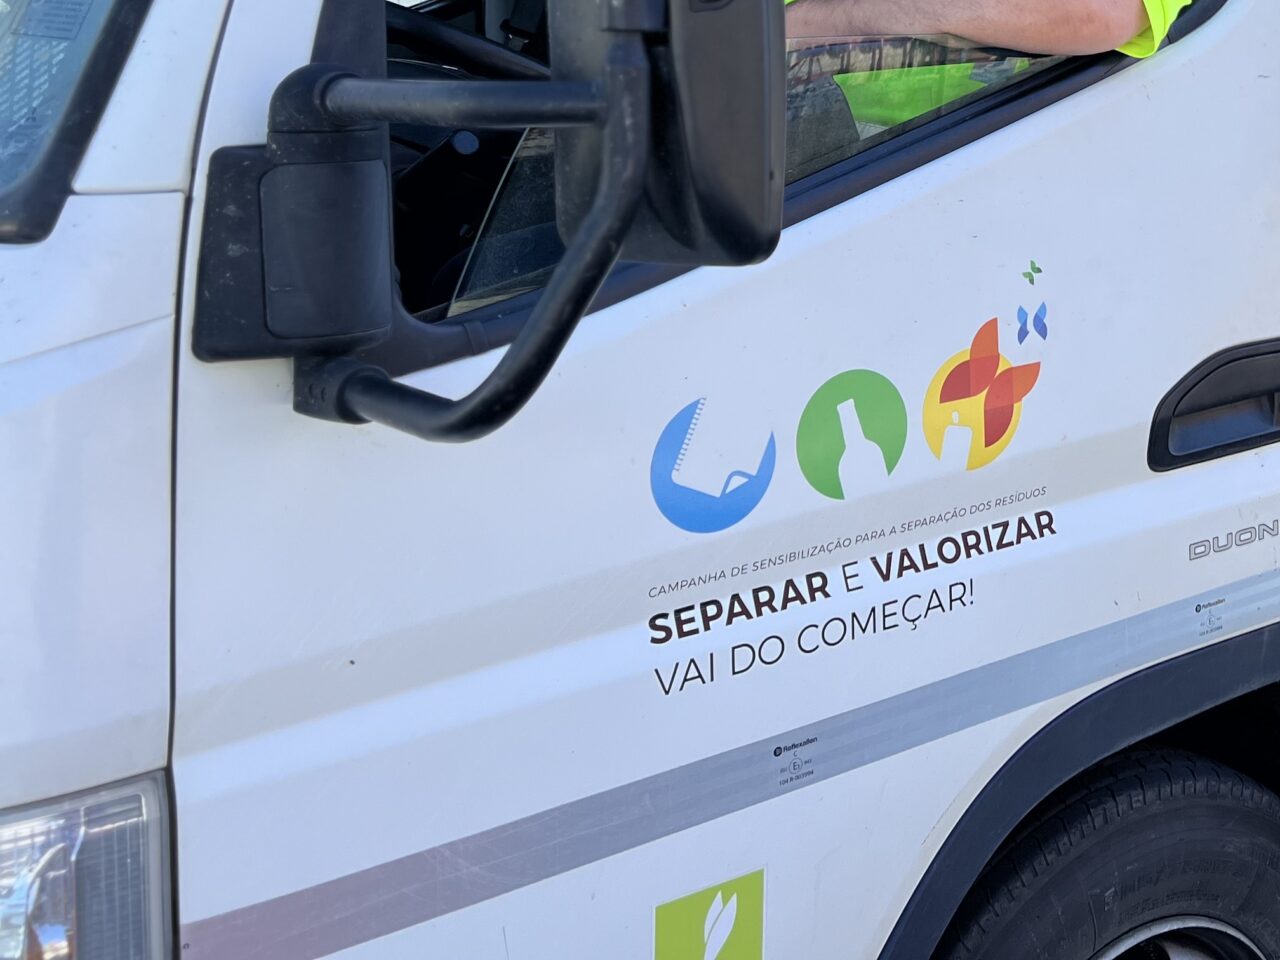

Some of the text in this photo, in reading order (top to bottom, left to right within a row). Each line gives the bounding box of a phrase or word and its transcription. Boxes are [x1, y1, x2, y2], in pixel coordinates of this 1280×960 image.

[647, 509, 1057, 646] SEPARAR E VALORIZAR
[648, 485, 1047, 599] CAMPANHA DE SENSIBILIZAÇÃO PARA A SEPARAÇÃO DOS RESÍDUOS
[654, 577, 975, 696] VAI DO COMEÇAR!
